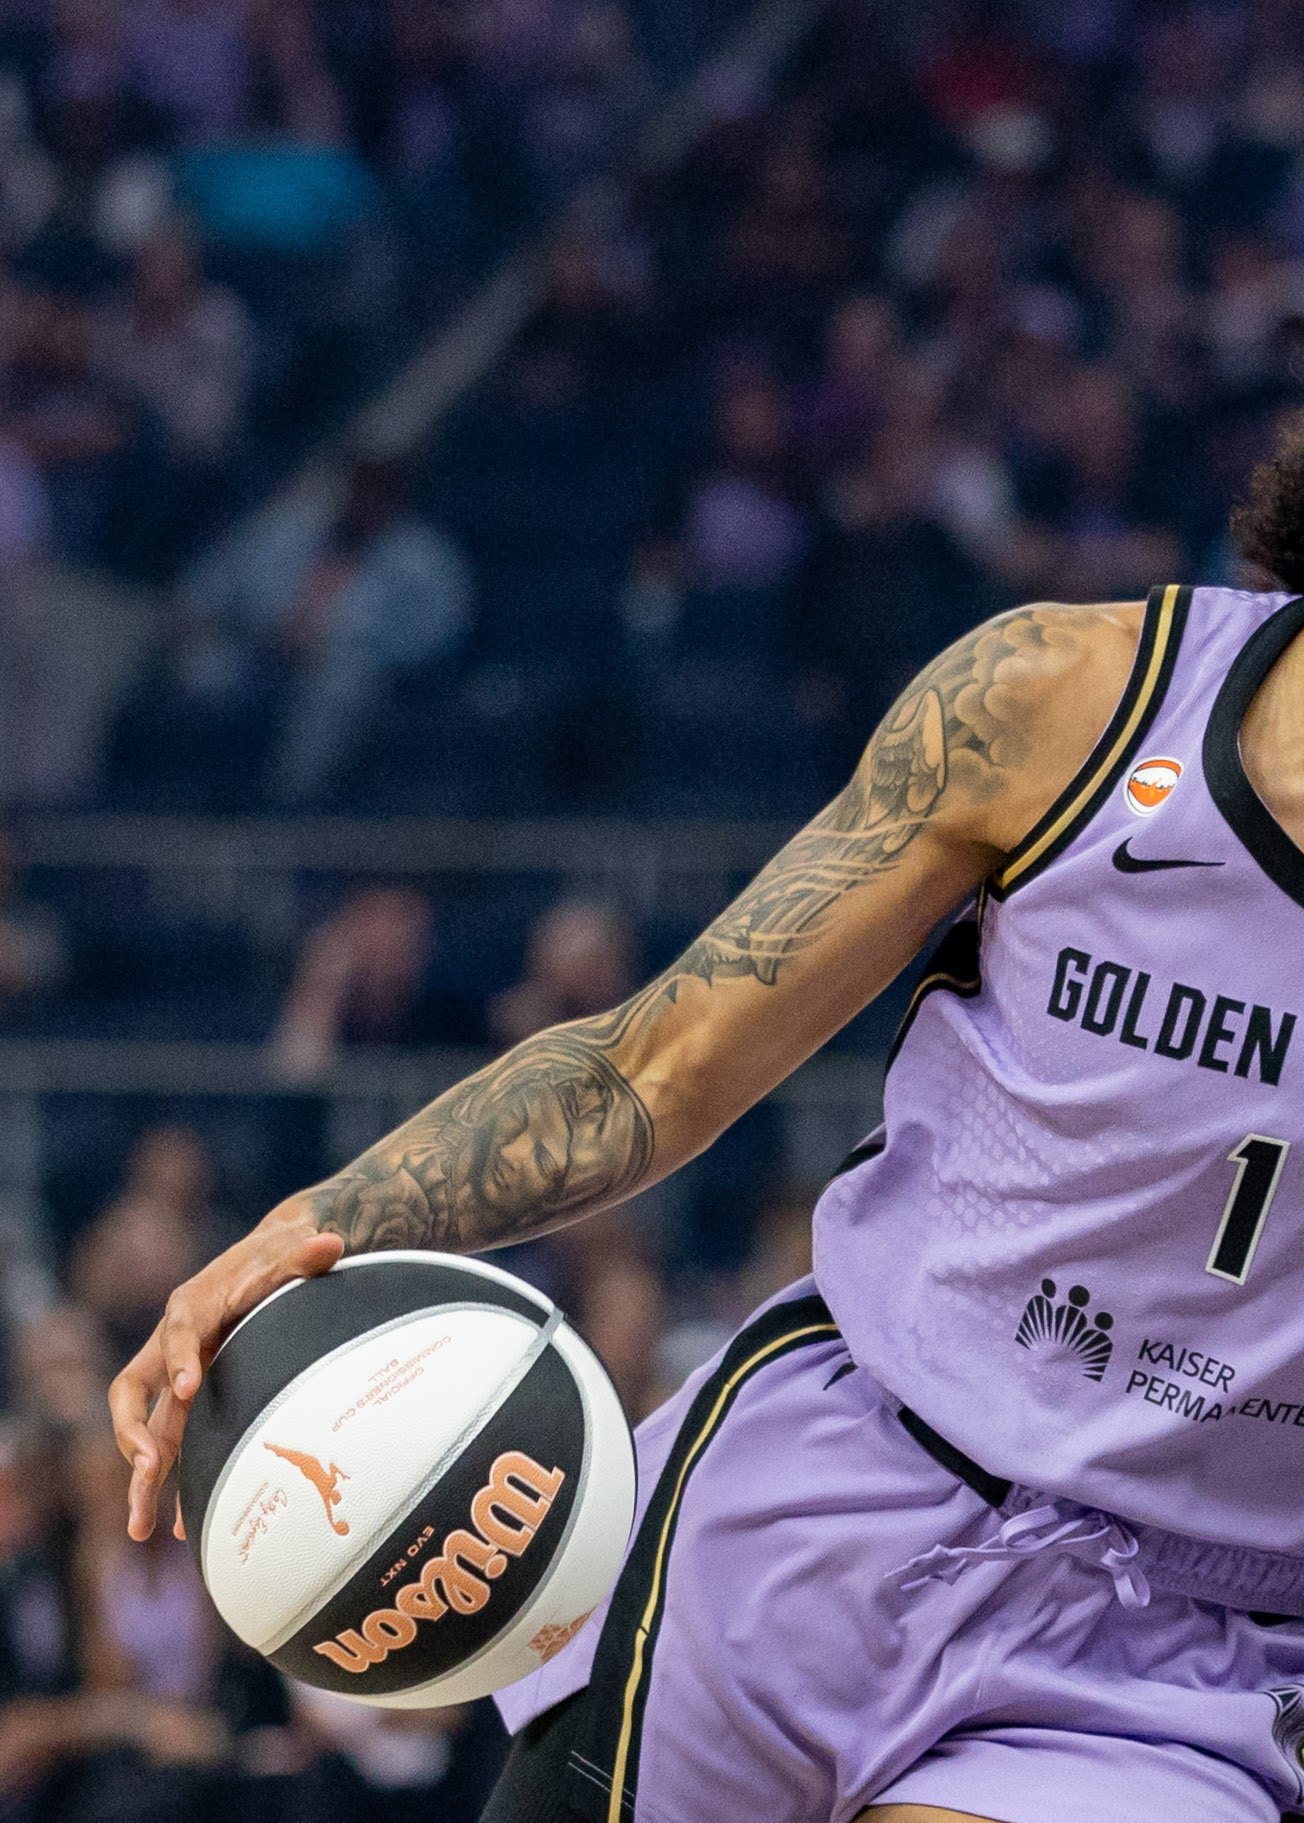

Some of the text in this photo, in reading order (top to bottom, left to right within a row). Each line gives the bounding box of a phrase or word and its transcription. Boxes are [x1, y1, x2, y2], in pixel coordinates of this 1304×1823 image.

[1046, 946, 1298, 1087] GOLDEN
[1205, 1132, 1291, 1286] 1
[367, 1358, 400, 1383] BALL
[1137, 1338, 1236, 1394] KAISER
[331, 1407, 356, 1433] CUP
[313, 1450, 566, 1674] Wilson
[380, 1525, 436, 1587] EVO NXT
